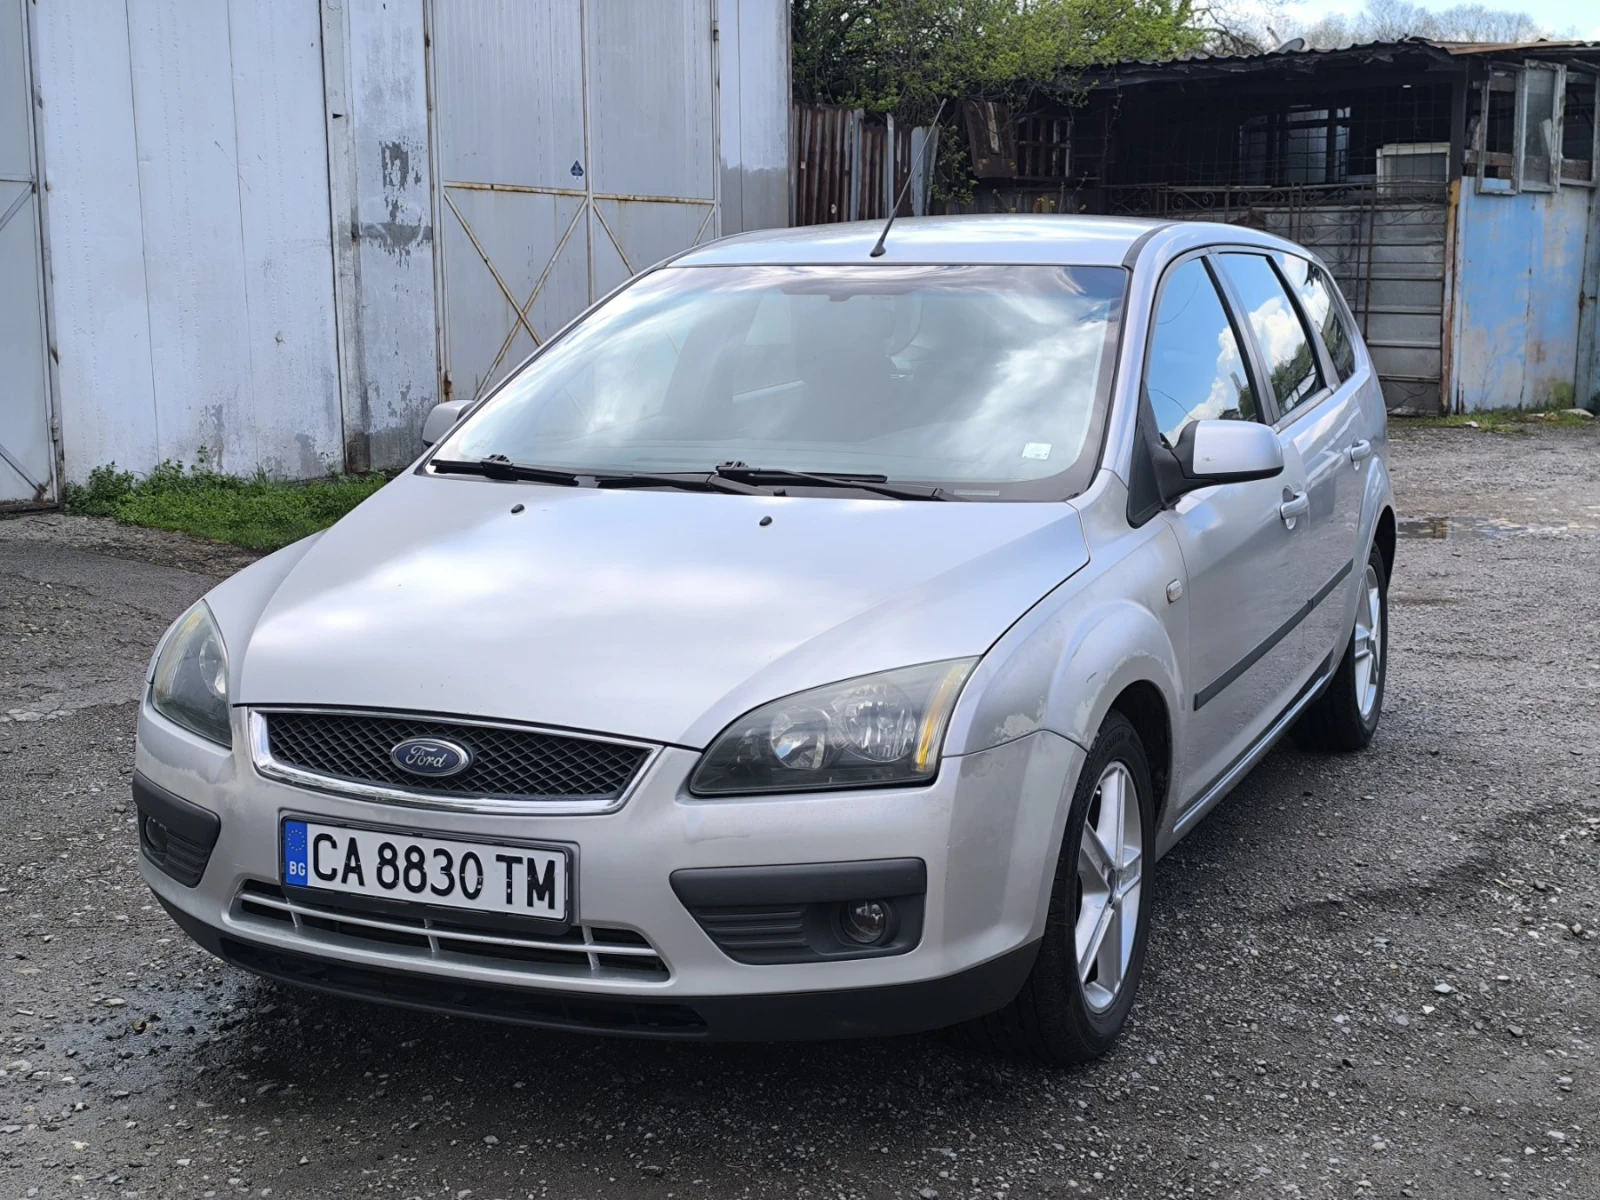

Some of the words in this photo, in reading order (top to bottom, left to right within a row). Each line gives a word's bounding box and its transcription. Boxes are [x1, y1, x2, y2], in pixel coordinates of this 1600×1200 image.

[405, 745, 447, 767] Ford
[289, 861, 306, 876] BG
[313, 833, 365, 886] CA
[376, 842, 483, 900] 8830
[495, 853, 555, 909] TM
